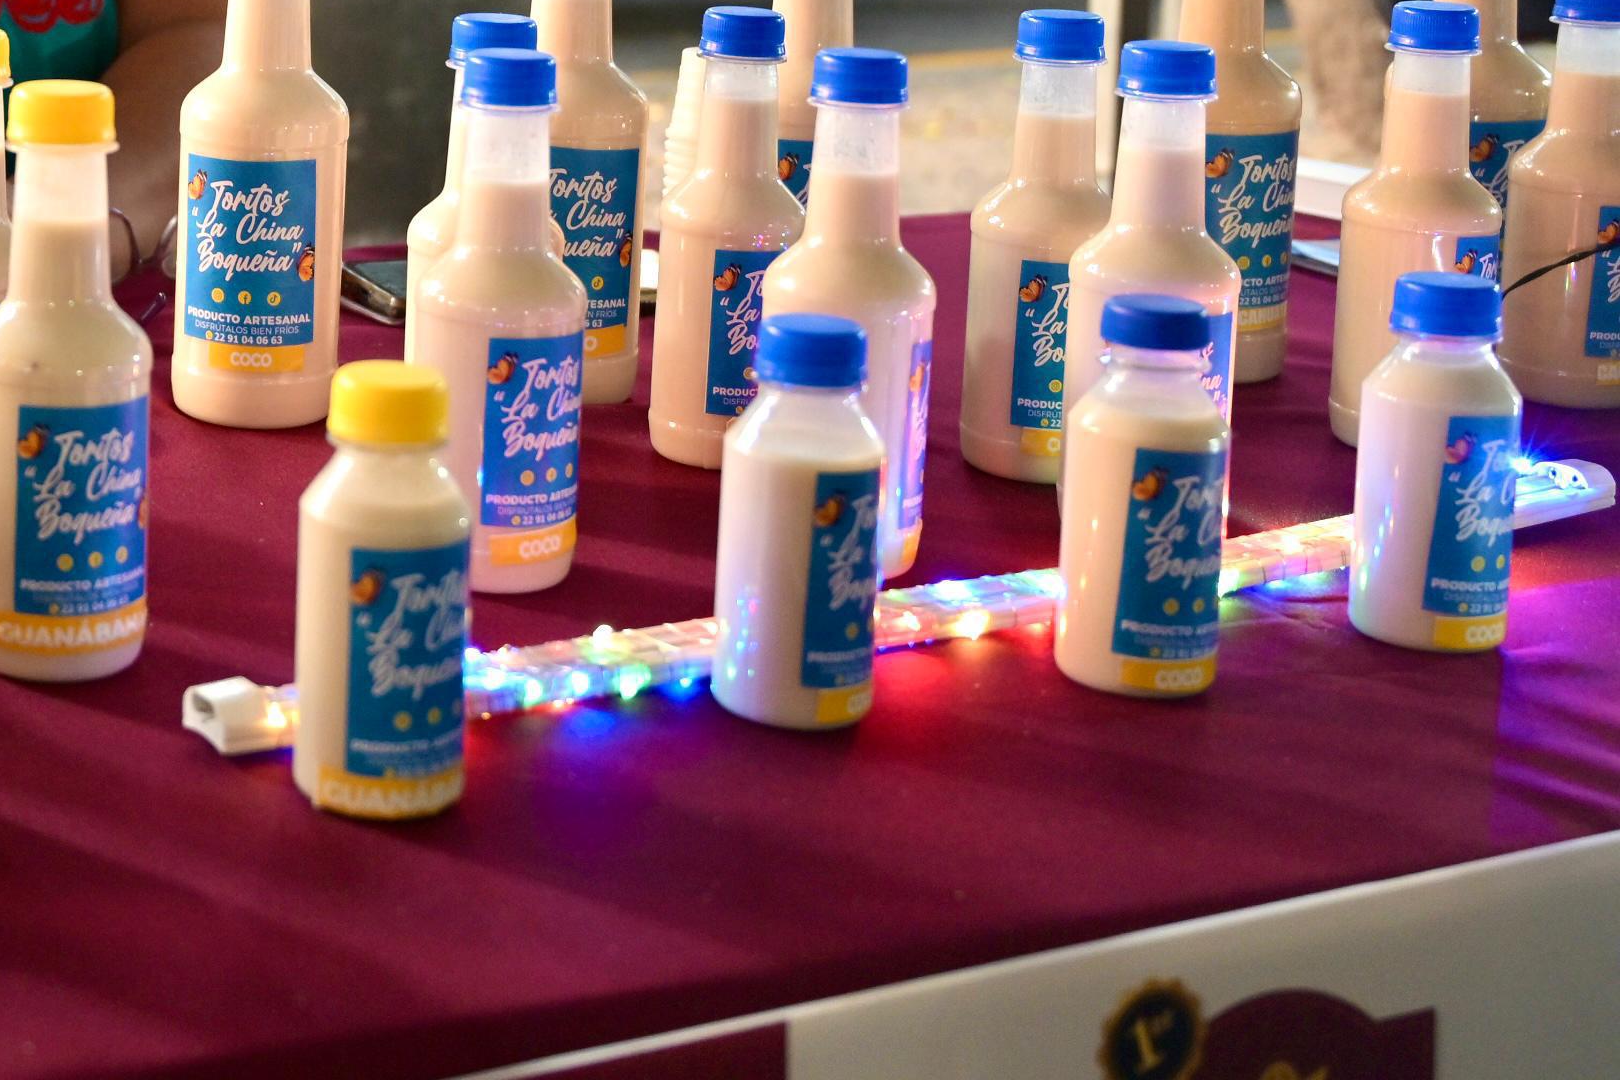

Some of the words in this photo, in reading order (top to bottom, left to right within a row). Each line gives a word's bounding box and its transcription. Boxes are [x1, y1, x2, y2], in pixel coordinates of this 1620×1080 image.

[209, 180, 290, 217] Toritos
[566, 199, 627, 231] China
[236, 214, 305, 245] China
[586, 297, 626, 309] TESANAL
[188, 306, 240, 324] PRODUCTO
[243, 313, 310, 325] ARTESANAL
[195, 320, 248, 334] DISFRÚTALOS
[251, 326, 272, 334] BIEN
[275, 325, 300, 334] FRÍOS
[592, 319, 602, 328] 63
[214, 333, 225, 342] 22
[227, 334, 238, 344] 91
[242, 335, 254, 344] 04
[256, 335, 268, 345] 06
[271, 335, 282, 344] 63
[230, 351, 272, 368] COCO
[1017, 398, 1062, 410] PRODUC
[1027, 409, 1062, 418] DISFRÚT
[1050, 419, 1062, 428] 22
[54, 427, 134, 476] Toritos
[485, 493, 548, 505] PRODUCTO
[522, 515, 532, 526] 22
[535, 514, 545, 524] 91
[518, 534, 561, 559] COCO
[19, 578, 91, 593] PRODUCTO
